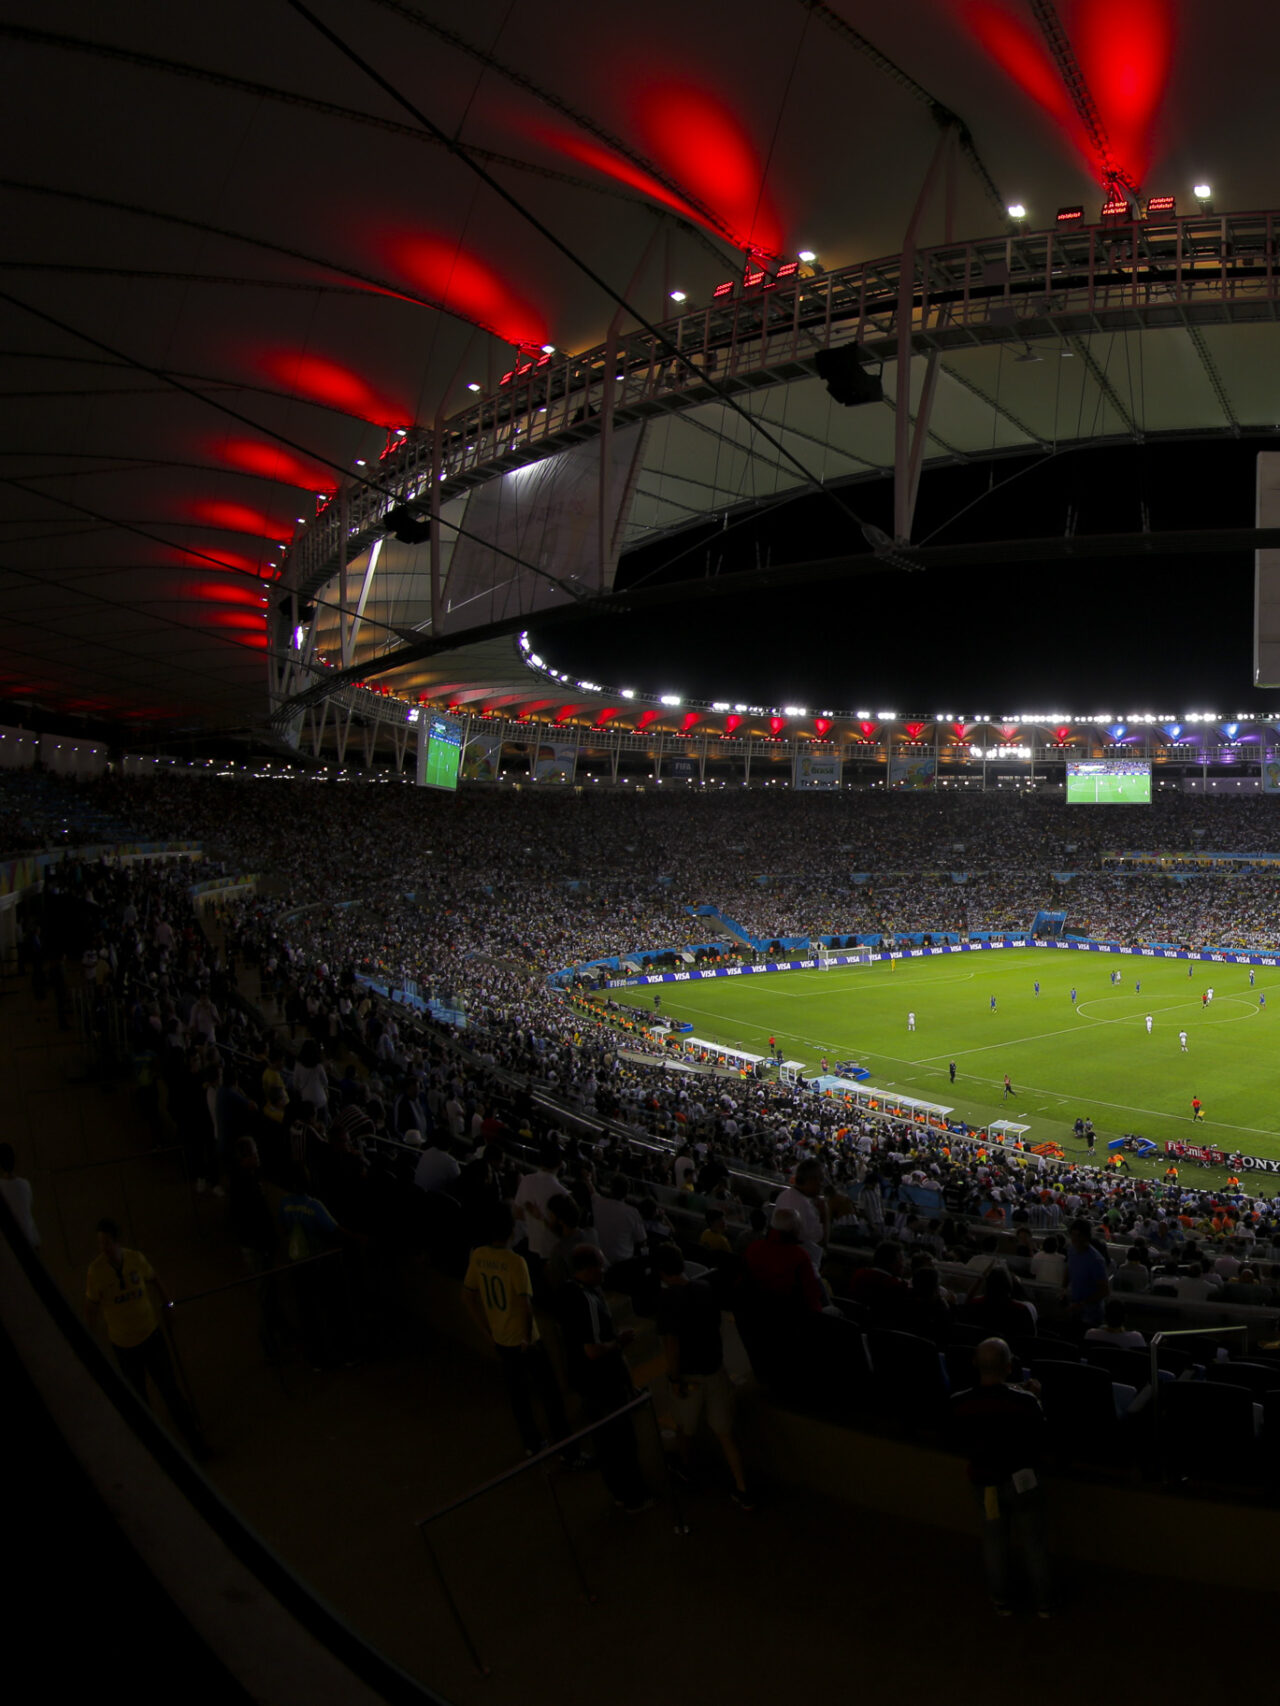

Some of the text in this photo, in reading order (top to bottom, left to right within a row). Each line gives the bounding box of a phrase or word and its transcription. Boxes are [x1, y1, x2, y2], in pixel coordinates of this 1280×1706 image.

[674, 972, 690, 981] VISA
[701, 970, 716, 978] VISA
[610, 979, 638, 988] FIFA.com
[647, 975, 663, 983] VISA
[480, 1272, 505, 1311] 10
